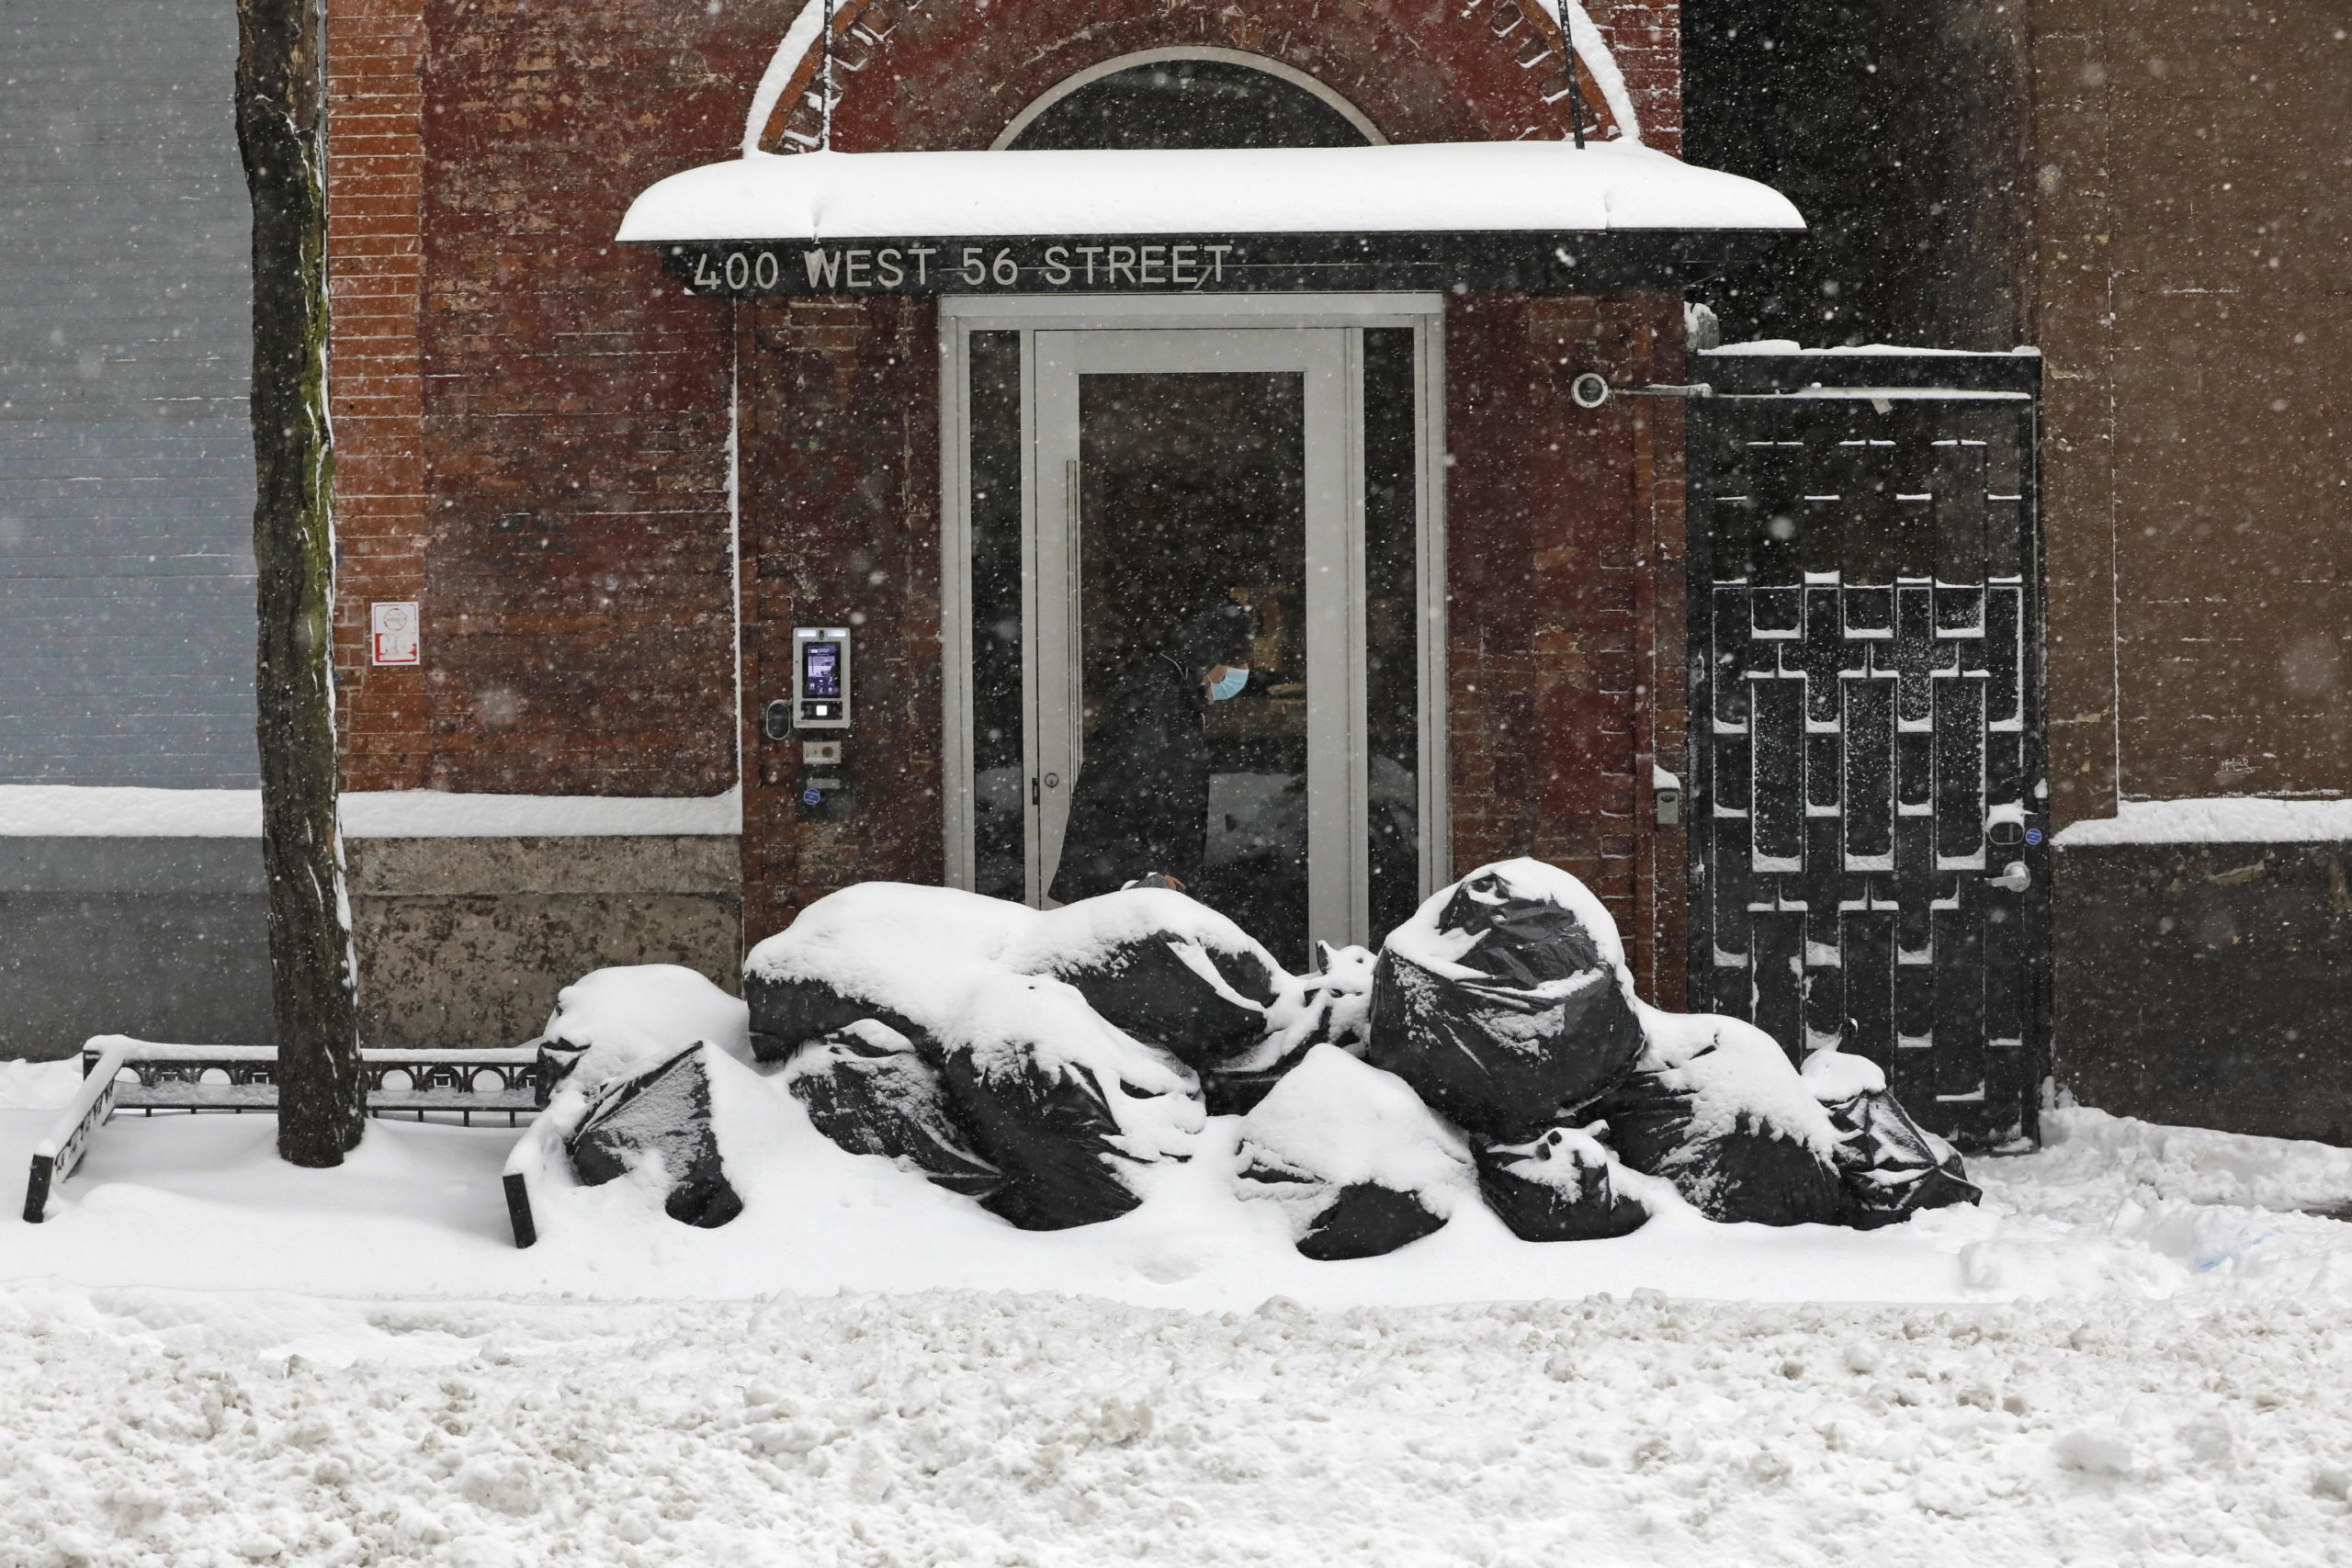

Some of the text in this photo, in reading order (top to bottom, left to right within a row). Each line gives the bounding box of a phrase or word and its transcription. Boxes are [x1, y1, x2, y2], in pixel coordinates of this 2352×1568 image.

[694, 244, 1232, 289] 400 WEST 56 STREET
